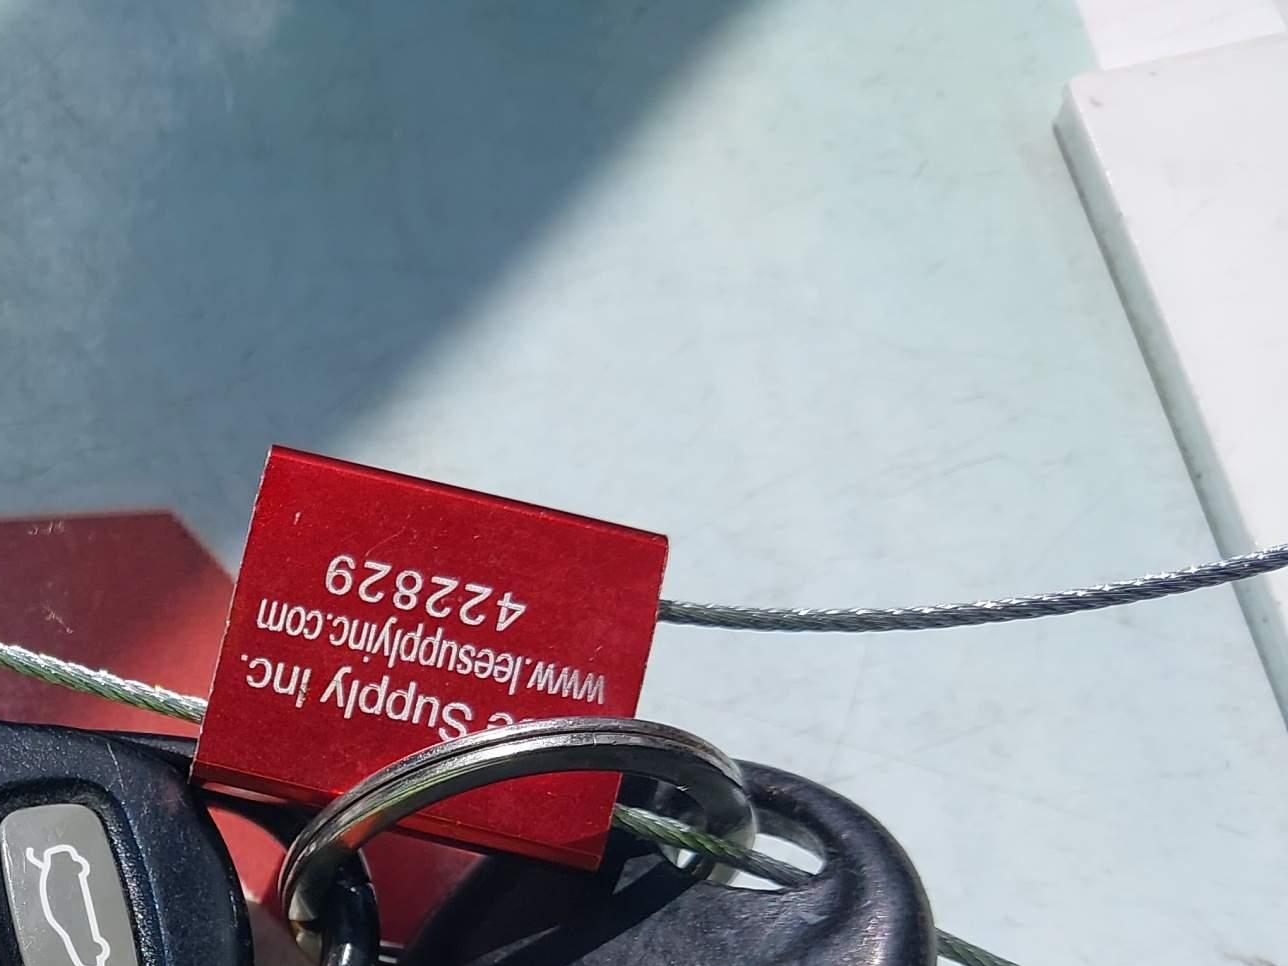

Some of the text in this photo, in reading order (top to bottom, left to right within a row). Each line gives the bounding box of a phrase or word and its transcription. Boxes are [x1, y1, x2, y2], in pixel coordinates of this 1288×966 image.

[325, 555, 527, 632] 422829
[256, 598, 606, 705] www.leesupplyinc.com
[240, 653, 473, 742] Supply Inc.
